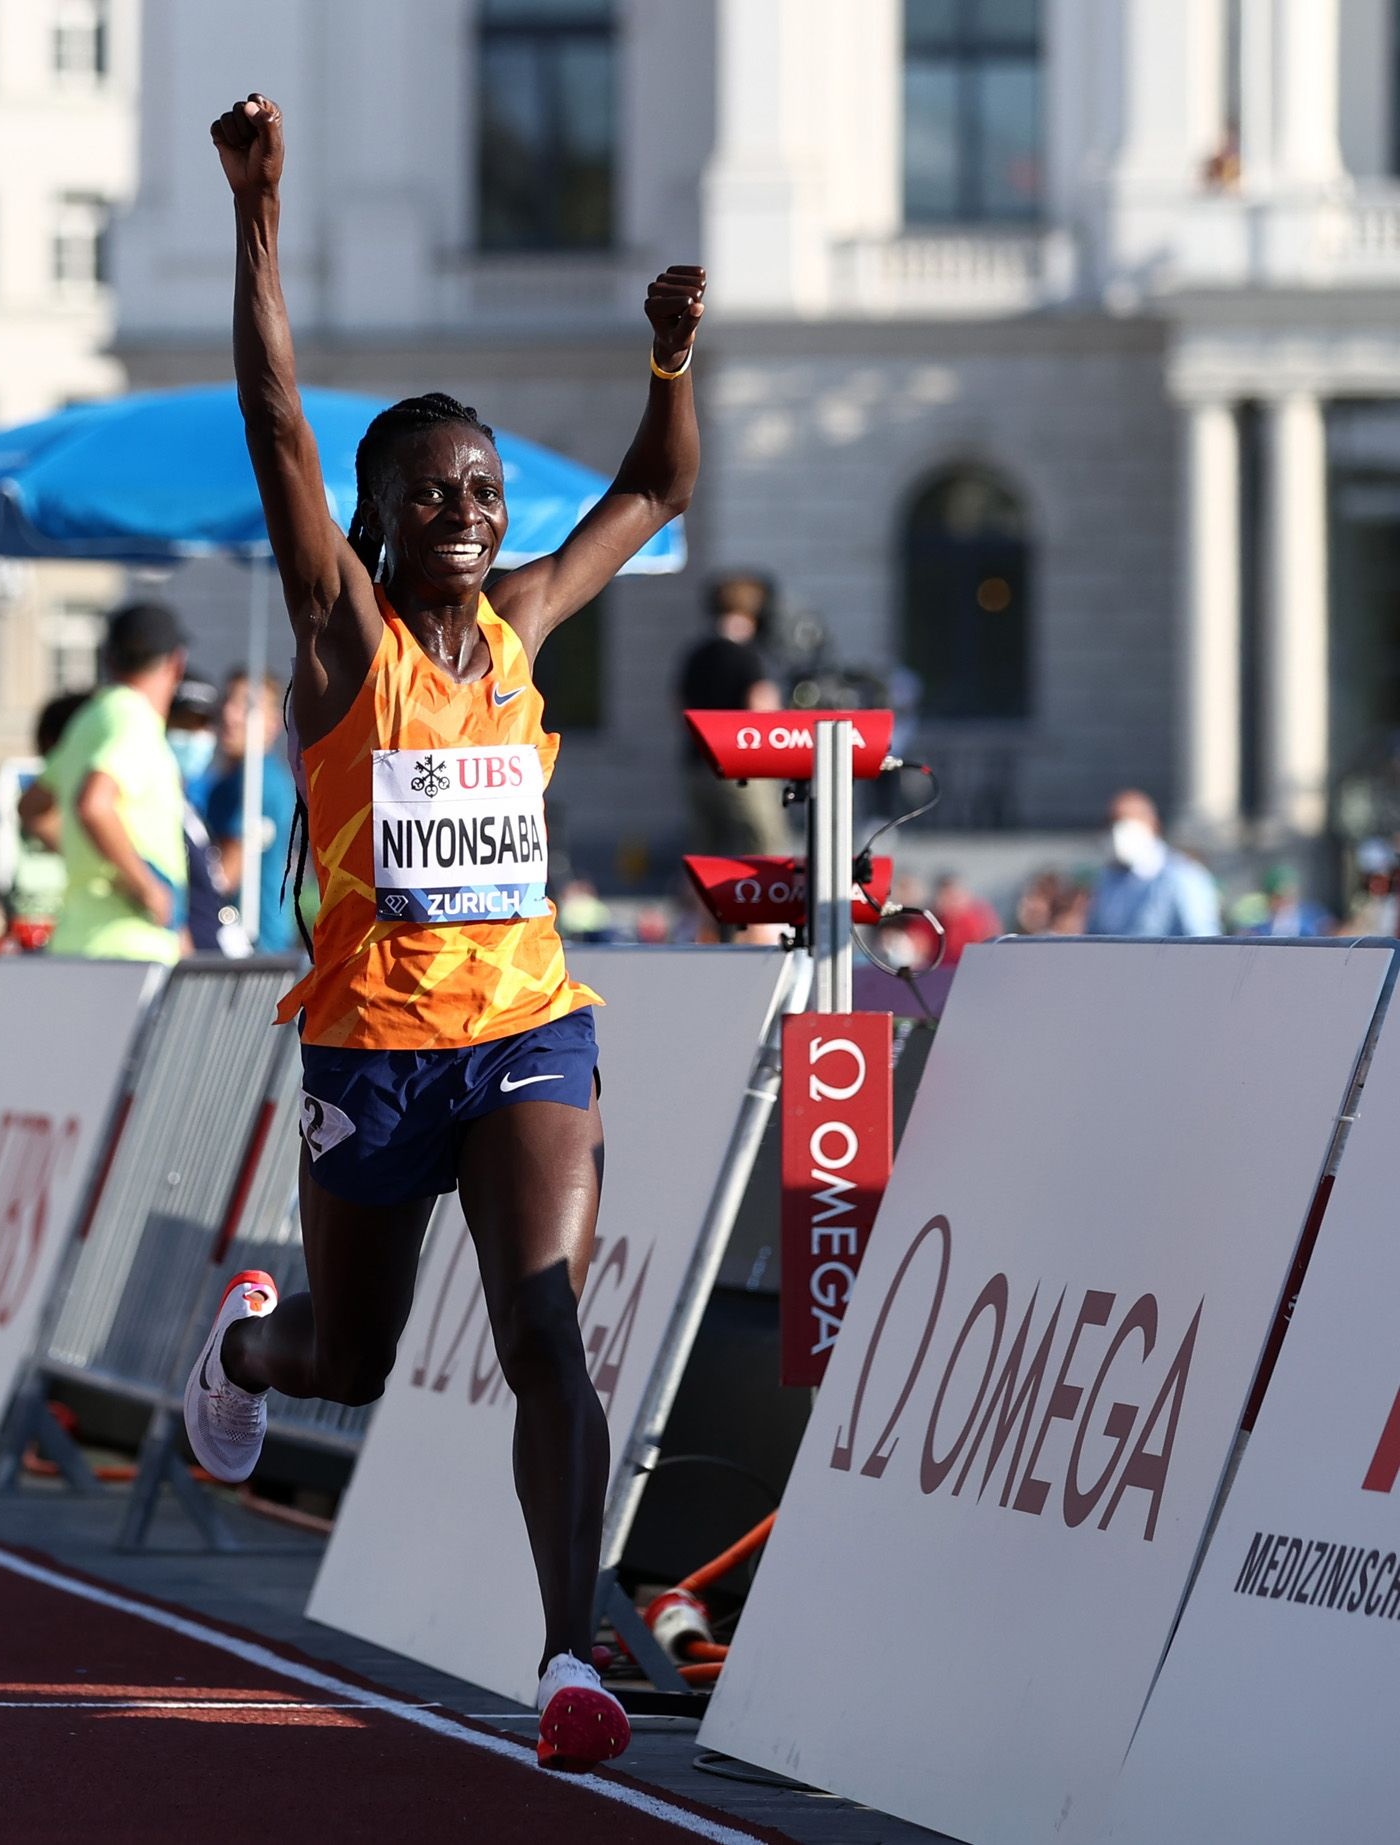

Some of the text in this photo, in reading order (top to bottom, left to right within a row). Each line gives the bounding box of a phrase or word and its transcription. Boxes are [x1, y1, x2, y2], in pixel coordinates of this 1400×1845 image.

[768, 727, 867, 750] OMA
[457, 755, 523, 790] UBS
[382, 814, 543, 869] NIYONSABA
[427, 889, 520, 916] ZURICH
[810, 1121, 859, 1356] OMEGA
[919, 1271, 1205, 1542] OMEGA
[1233, 1531, 1400, 1621] MEDIZINISCH
